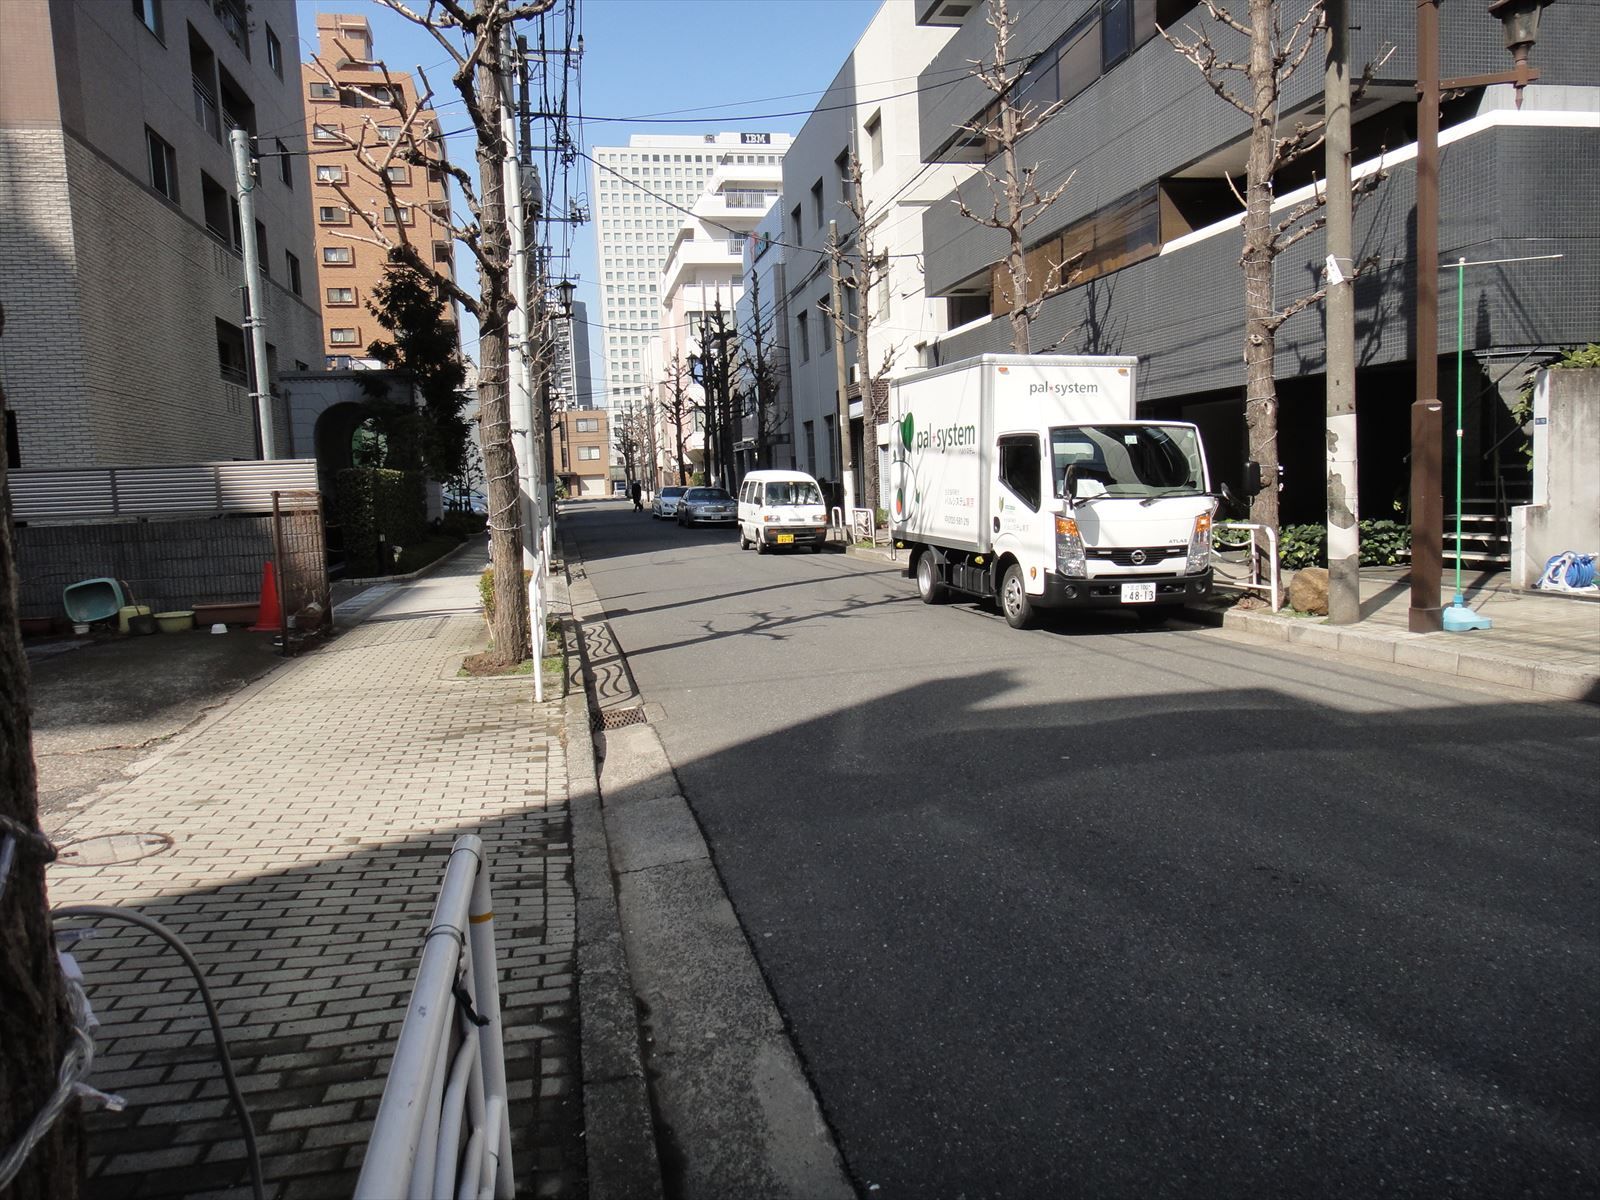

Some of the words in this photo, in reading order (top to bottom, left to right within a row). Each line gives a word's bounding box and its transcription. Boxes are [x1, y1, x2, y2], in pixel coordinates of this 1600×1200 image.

[745, 133, 766, 143] IBM
[1029, 380, 1048, 396] pal
[1054, 382, 1098, 397] system
[916, 422, 932, 456] pal
[936, 422, 976, 455] system
[1129, 590, 1154, 601] 48-13
